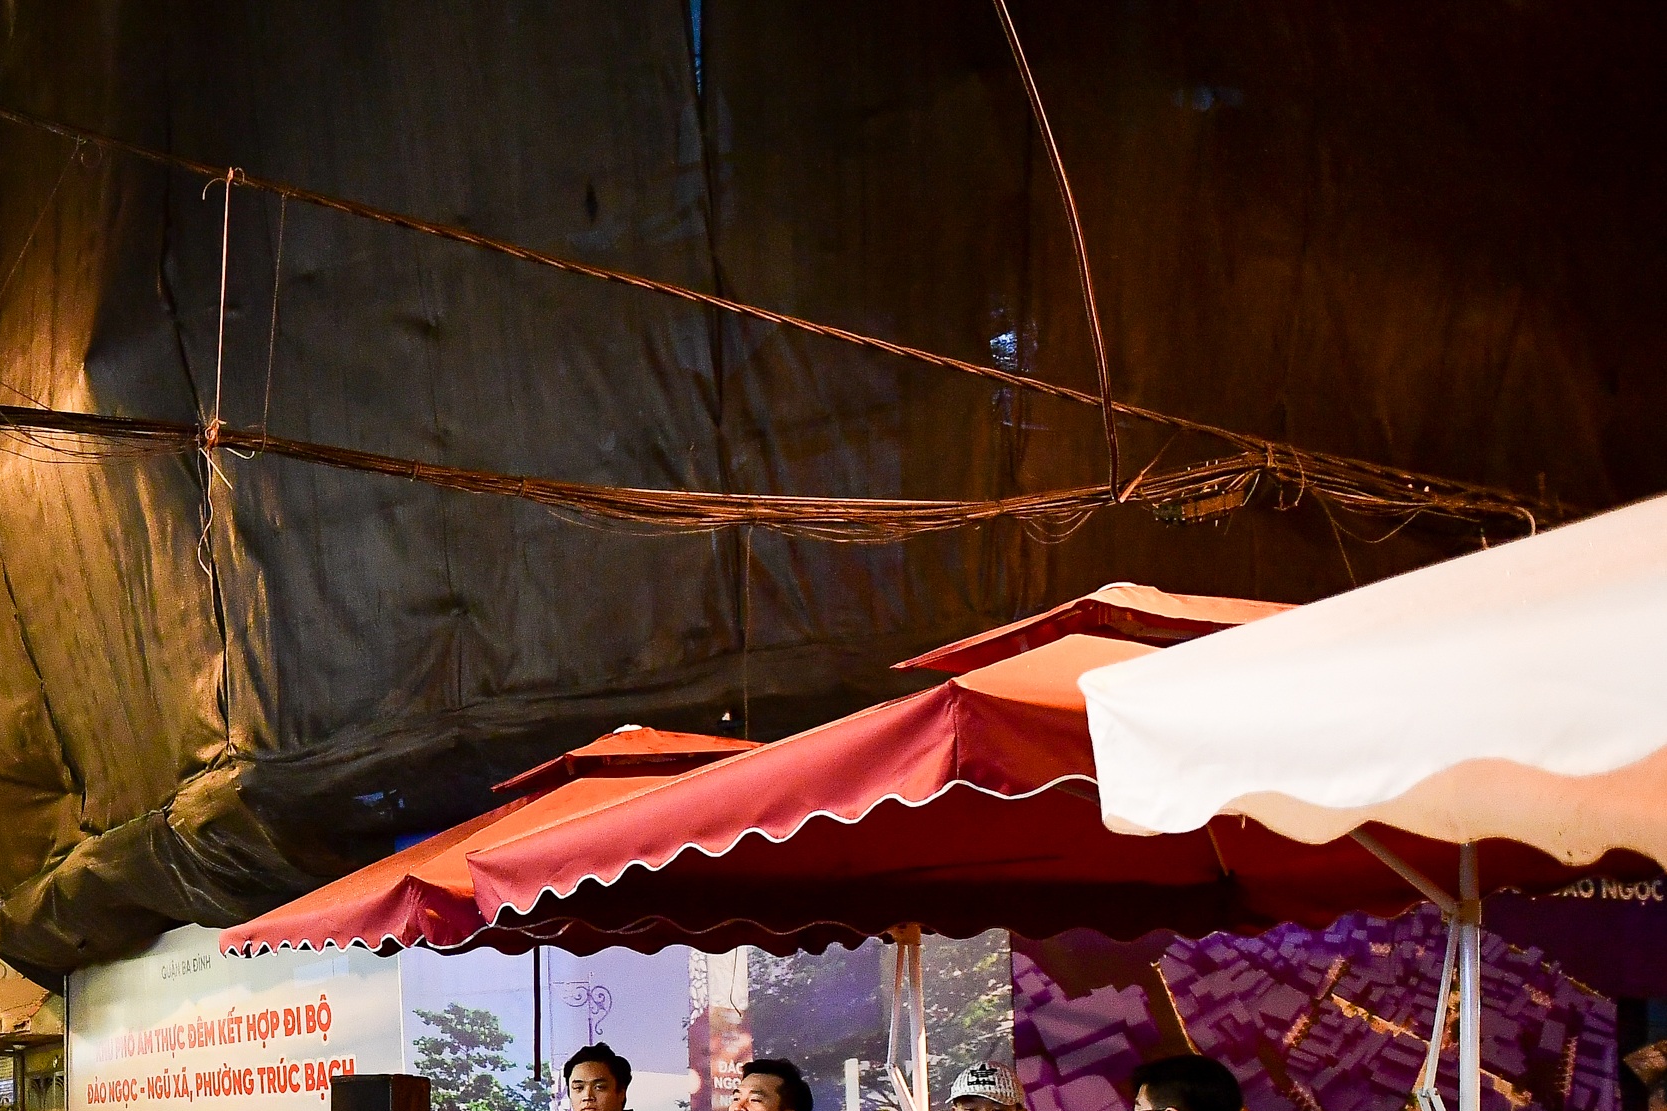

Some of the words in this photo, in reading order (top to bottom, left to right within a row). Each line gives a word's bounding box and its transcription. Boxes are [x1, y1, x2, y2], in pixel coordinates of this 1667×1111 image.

[155, 1023, 186, 1058] THỰC
[187, 1016, 216, 1049] ĐÊM
[217, 1007, 243, 1045] KẾT
[246, 1008, 280, 1049] HỢP
[283, 1007, 302, 1037] ĐI
[305, 994, 332, 1041] BỘ
[87, 1075, 107, 1105] ĐẢO
[108, 1078, 138, 1109] NGỌC
[147, 1068, 171, 1100] NGŨ
[196, 1063, 254, 1097] PHƯỜNG
[257, 1057, 300, 1094] TRÚC
